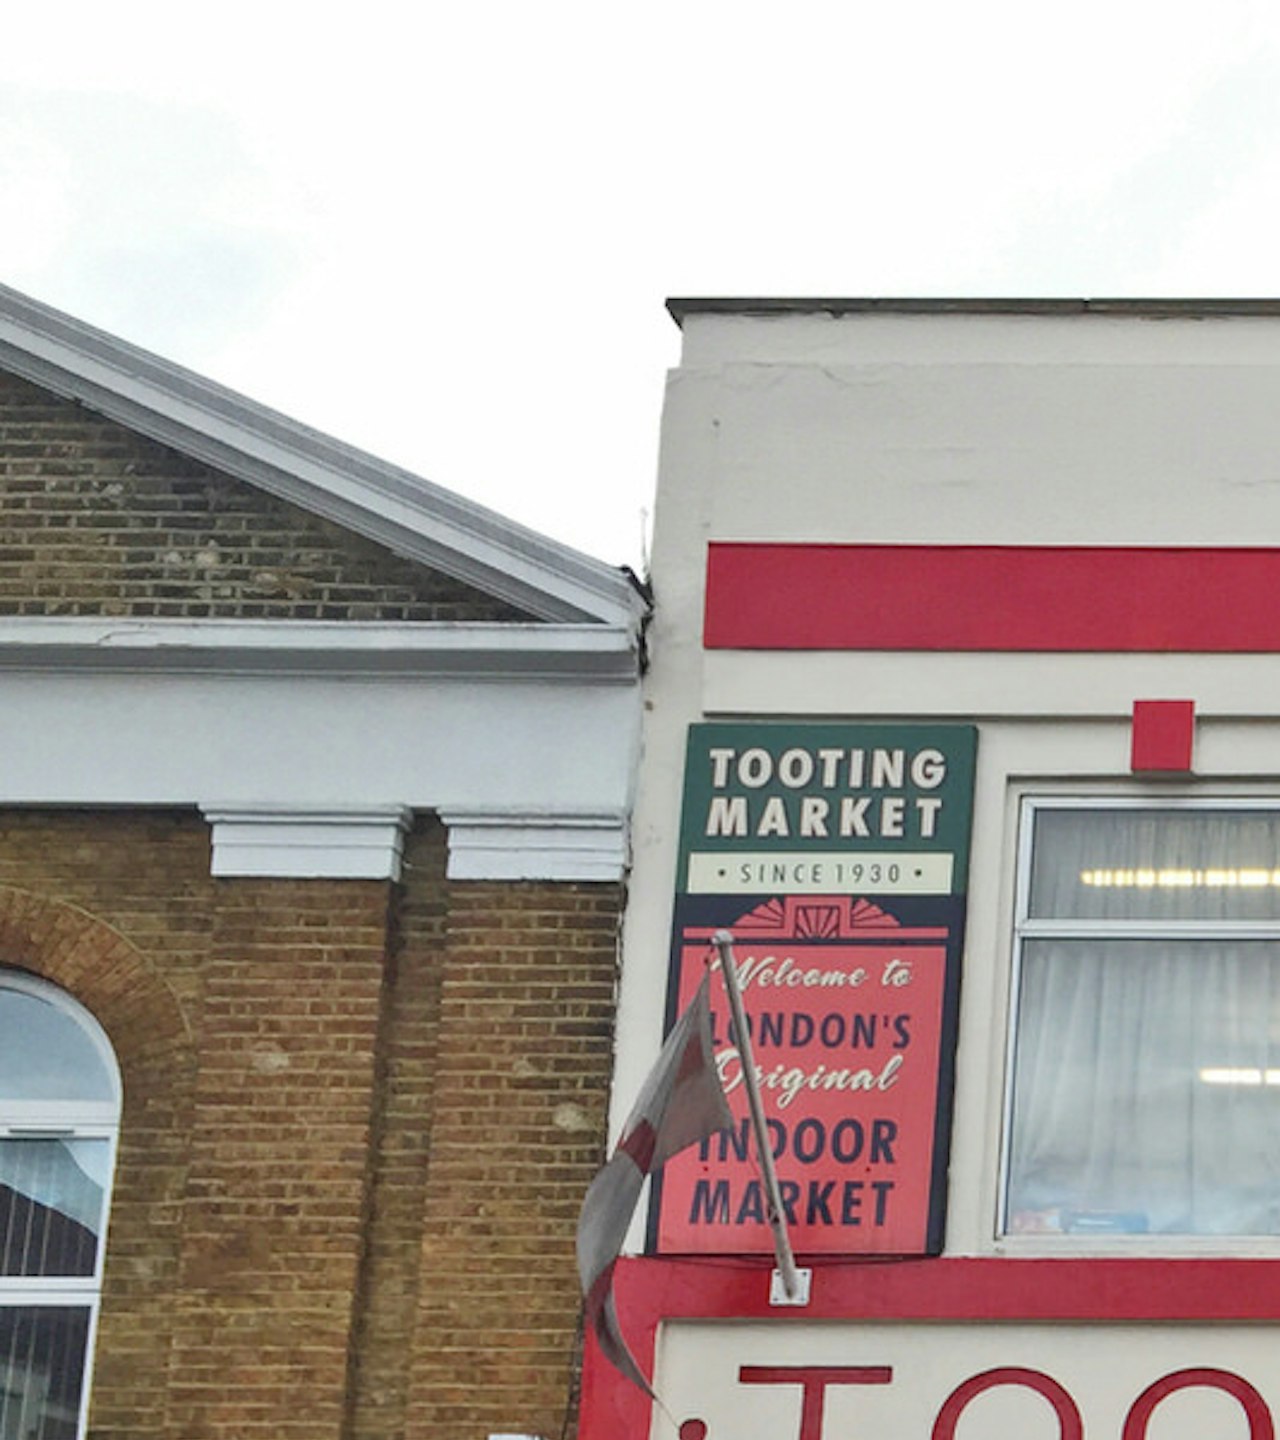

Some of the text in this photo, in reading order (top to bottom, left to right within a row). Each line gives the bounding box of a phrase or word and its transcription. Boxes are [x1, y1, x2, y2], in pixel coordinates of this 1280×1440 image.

[707, 746, 947, 790] TOOTING
[704, 796, 943, 839] MARKET
[740, 863, 901, 884] SINCE 1930
[882, 959, 912, 987] to
[689, 1180, 894, 1227] MARKET
